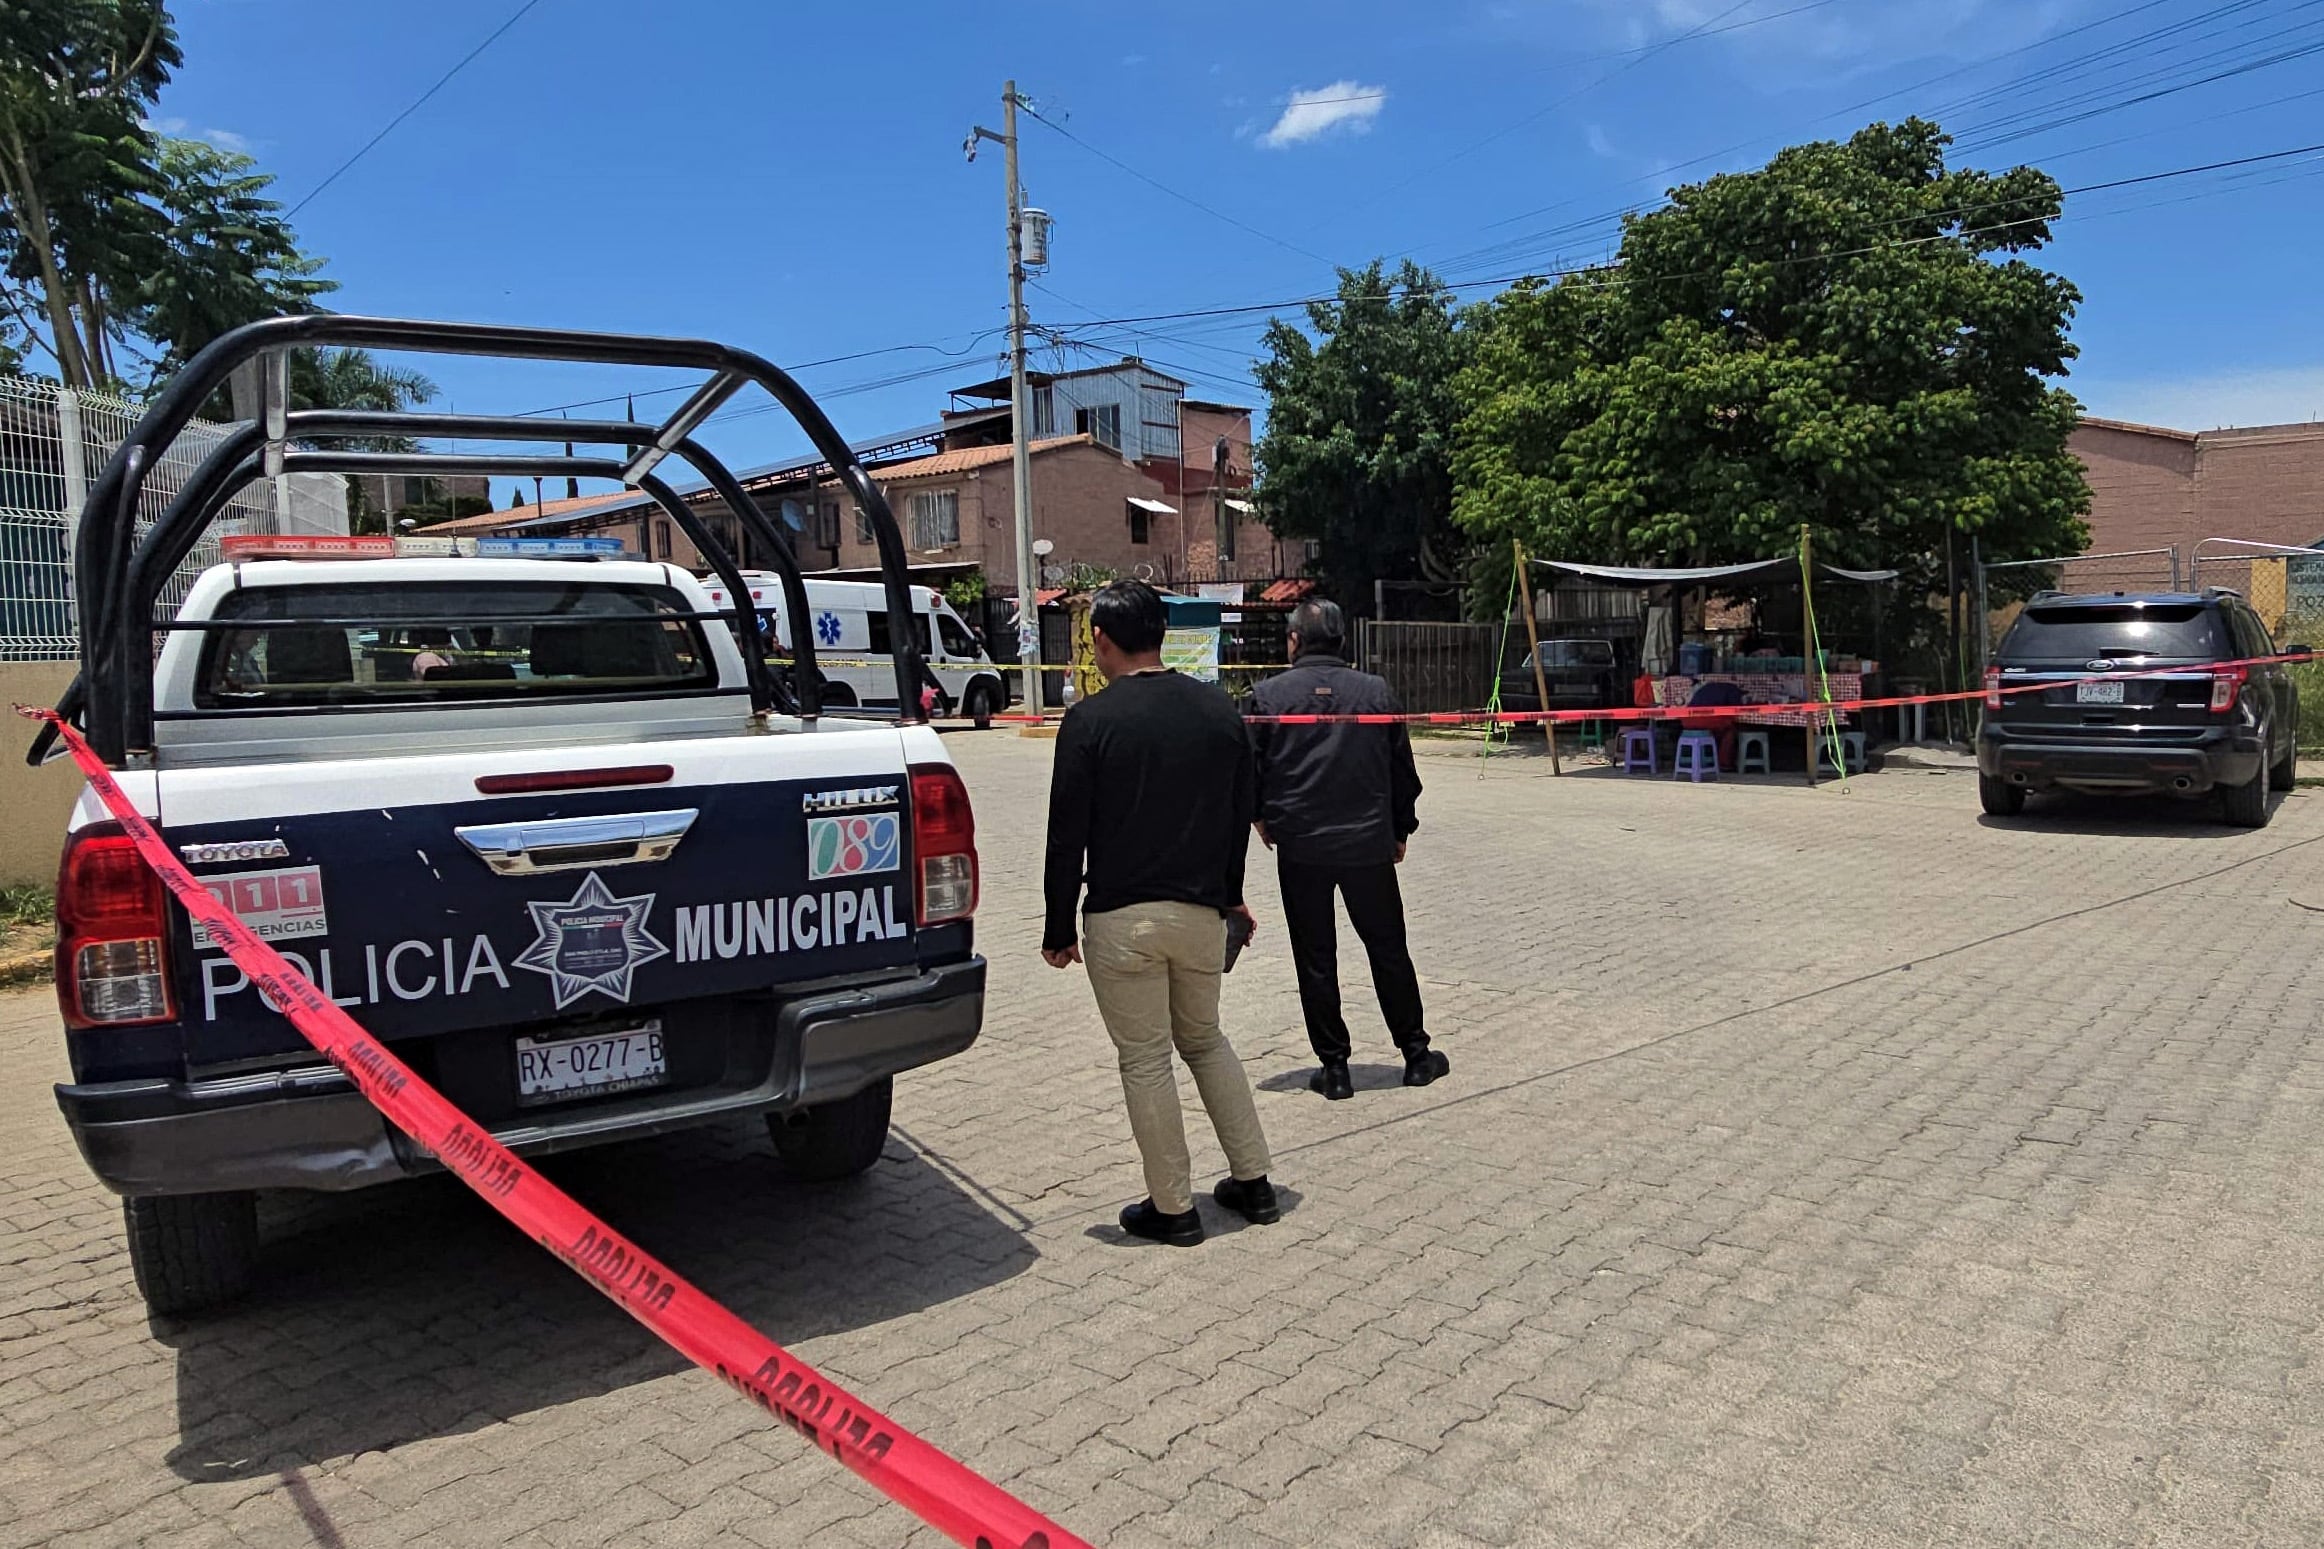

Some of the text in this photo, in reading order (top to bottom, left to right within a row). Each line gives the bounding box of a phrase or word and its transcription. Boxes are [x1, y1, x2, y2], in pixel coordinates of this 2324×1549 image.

[803, 785, 899, 812] HILUX
[180, 838, 290, 864] TOYOTA
[811, 816, 898, 876] 089
[675, 885, 907, 963] MUNICIPAL
[521, 1033, 664, 1082] RX-0277-B
